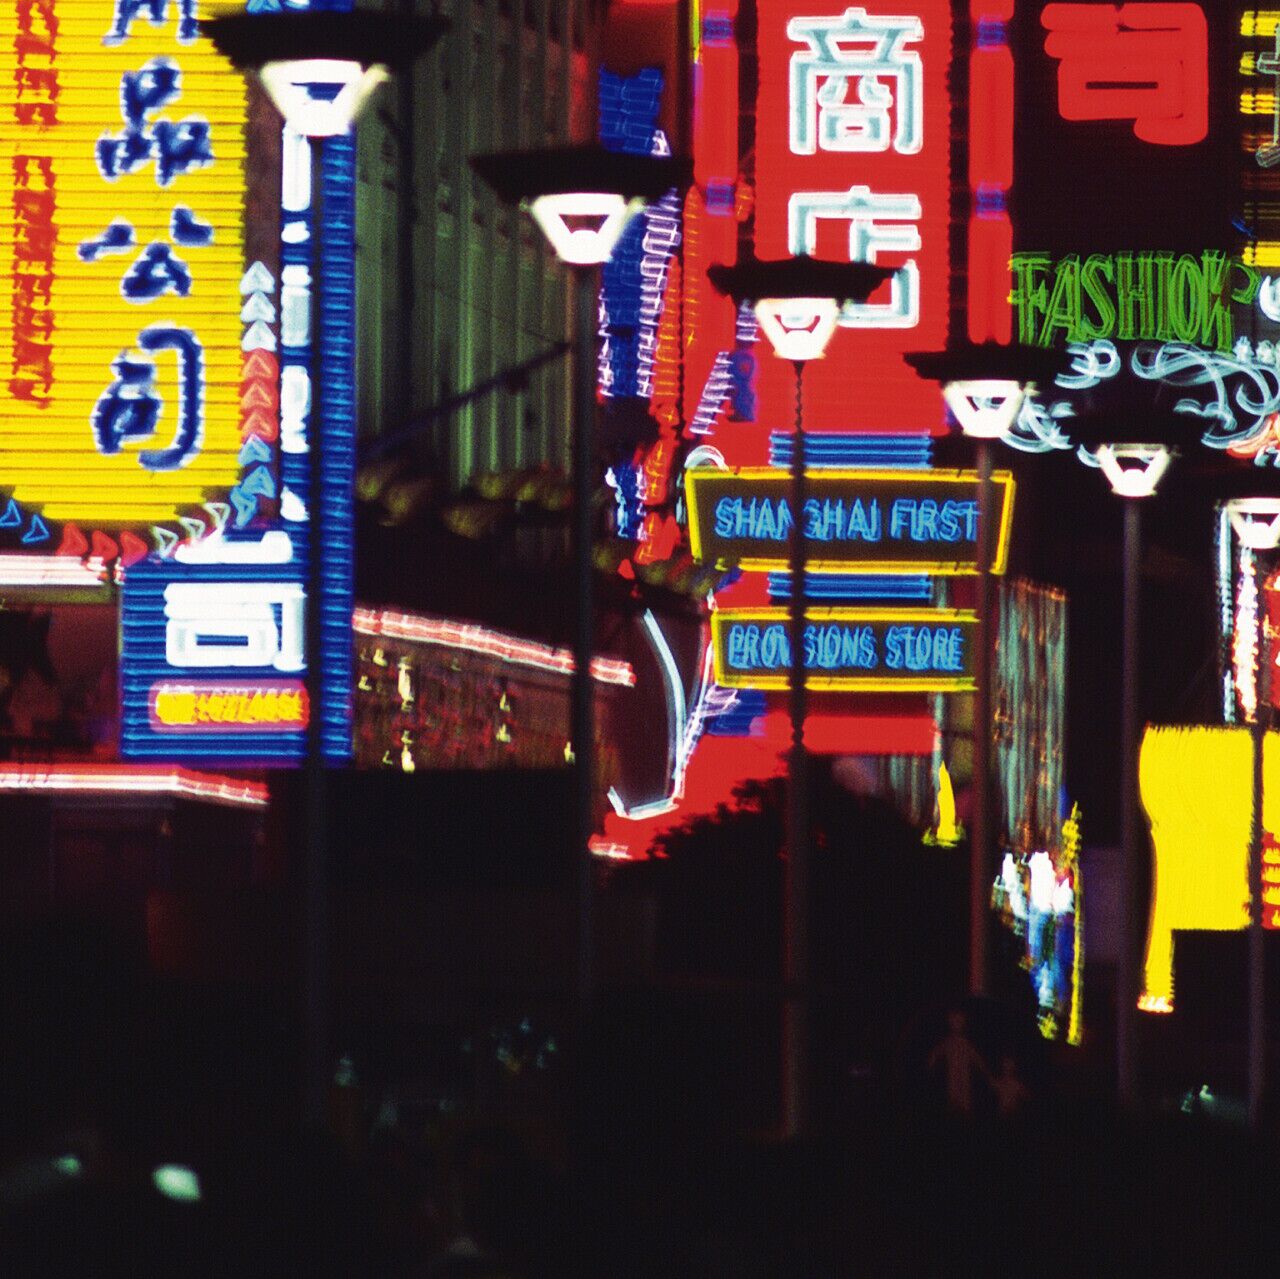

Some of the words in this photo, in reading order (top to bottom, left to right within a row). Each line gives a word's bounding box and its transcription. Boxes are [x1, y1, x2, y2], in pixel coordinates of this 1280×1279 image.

[889, 498, 981, 542] FIRST
[727, 624, 878, 670] PROVSIONS
[885, 626, 965, 671] STORE
